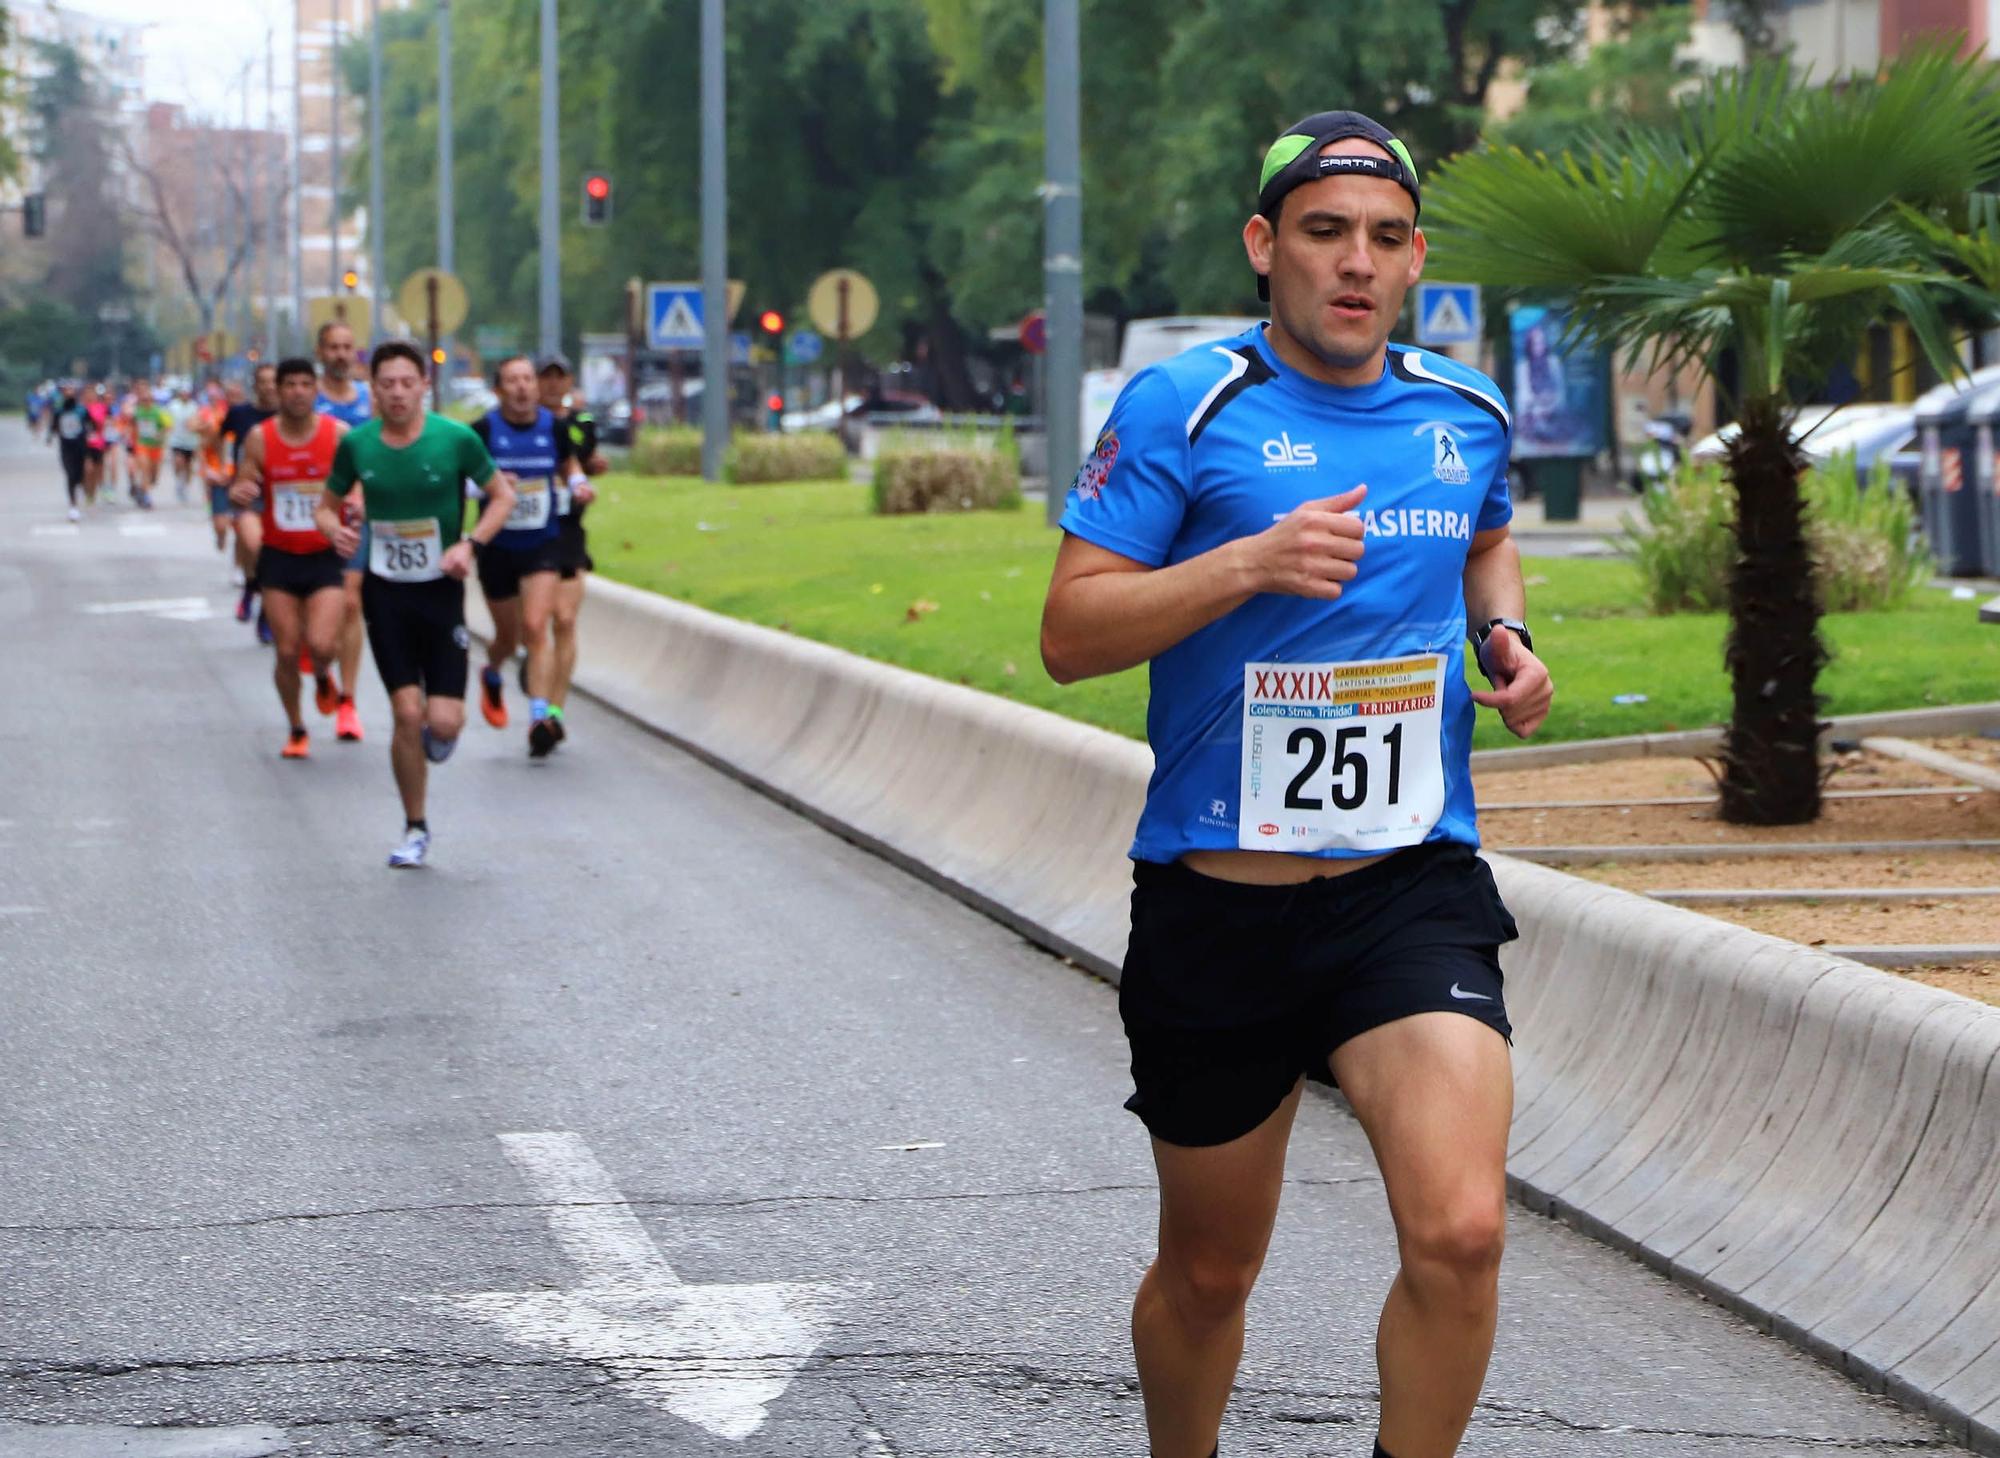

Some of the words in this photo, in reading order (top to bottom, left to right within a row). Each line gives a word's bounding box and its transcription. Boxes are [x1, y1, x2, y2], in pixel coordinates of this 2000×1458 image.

[384, 542, 428, 571] 263
[1335, 666, 1370, 678] CARRERA
[1371, 663, 1405, 674] POPULAR
[1379, 674, 1412, 684] TRINIDAD
[1254, 670, 1332, 700] XXXIX
[1250, 704, 1286, 718] Colegio
[1288, 706, 1315, 718] Stma.
[1318, 705, 1353, 718] Trinidad
[1362, 695, 1435, 716] TRINITARIOS
[1284, 722, 1403, 811] 251
